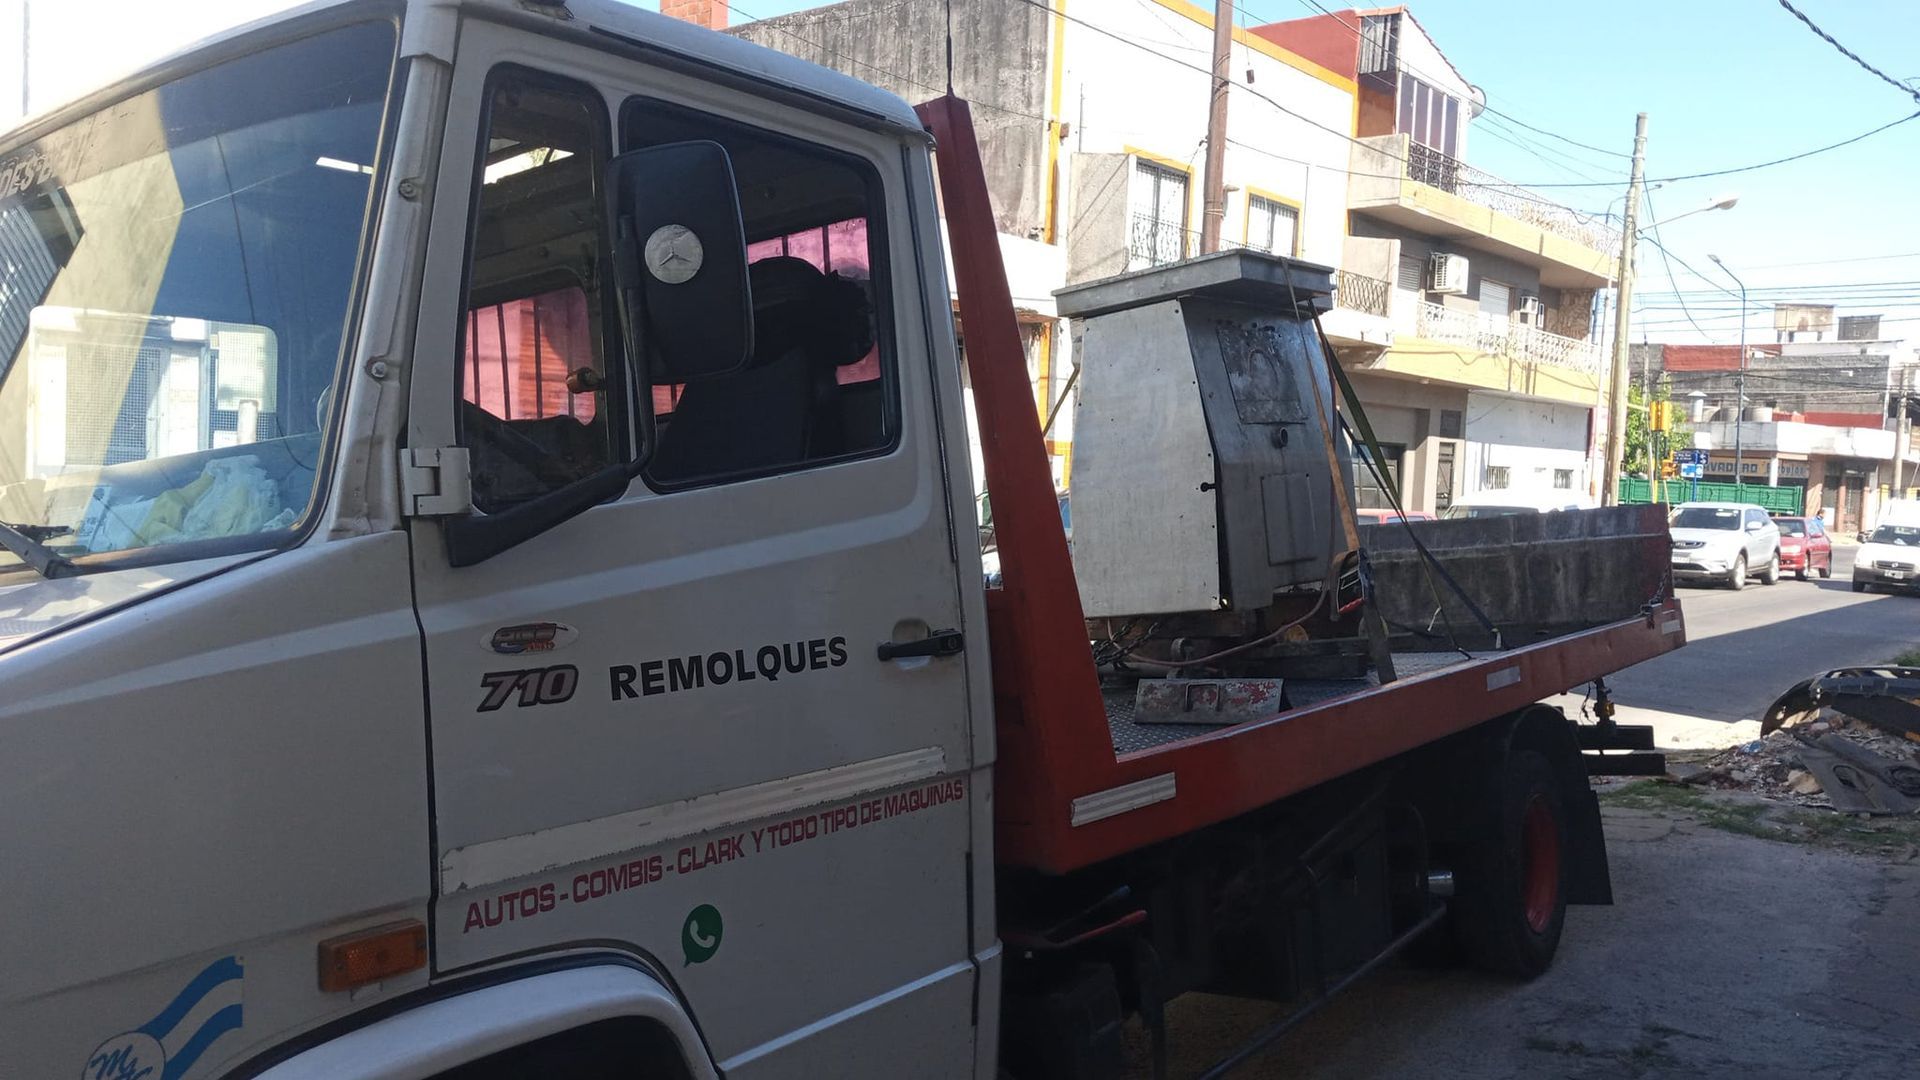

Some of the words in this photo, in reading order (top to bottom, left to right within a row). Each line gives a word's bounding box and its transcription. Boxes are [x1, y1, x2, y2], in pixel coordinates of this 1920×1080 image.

[477, 664, 579, 712] 710
[609, 636, 848, 701] REMOLQUES
[463, 882, 556, 934] AUTOS
[572, 855, 663, 903] COMBIS
[678, 833, 745, 874] CLARK
[751, 828, 764, 853] Y
[767, 815, 818, 849] TODO
[820, 804, 857, 835] TIPO
[860, 799, 882, 825] DE
[883, 779, 963, 819] MAQUINAS
